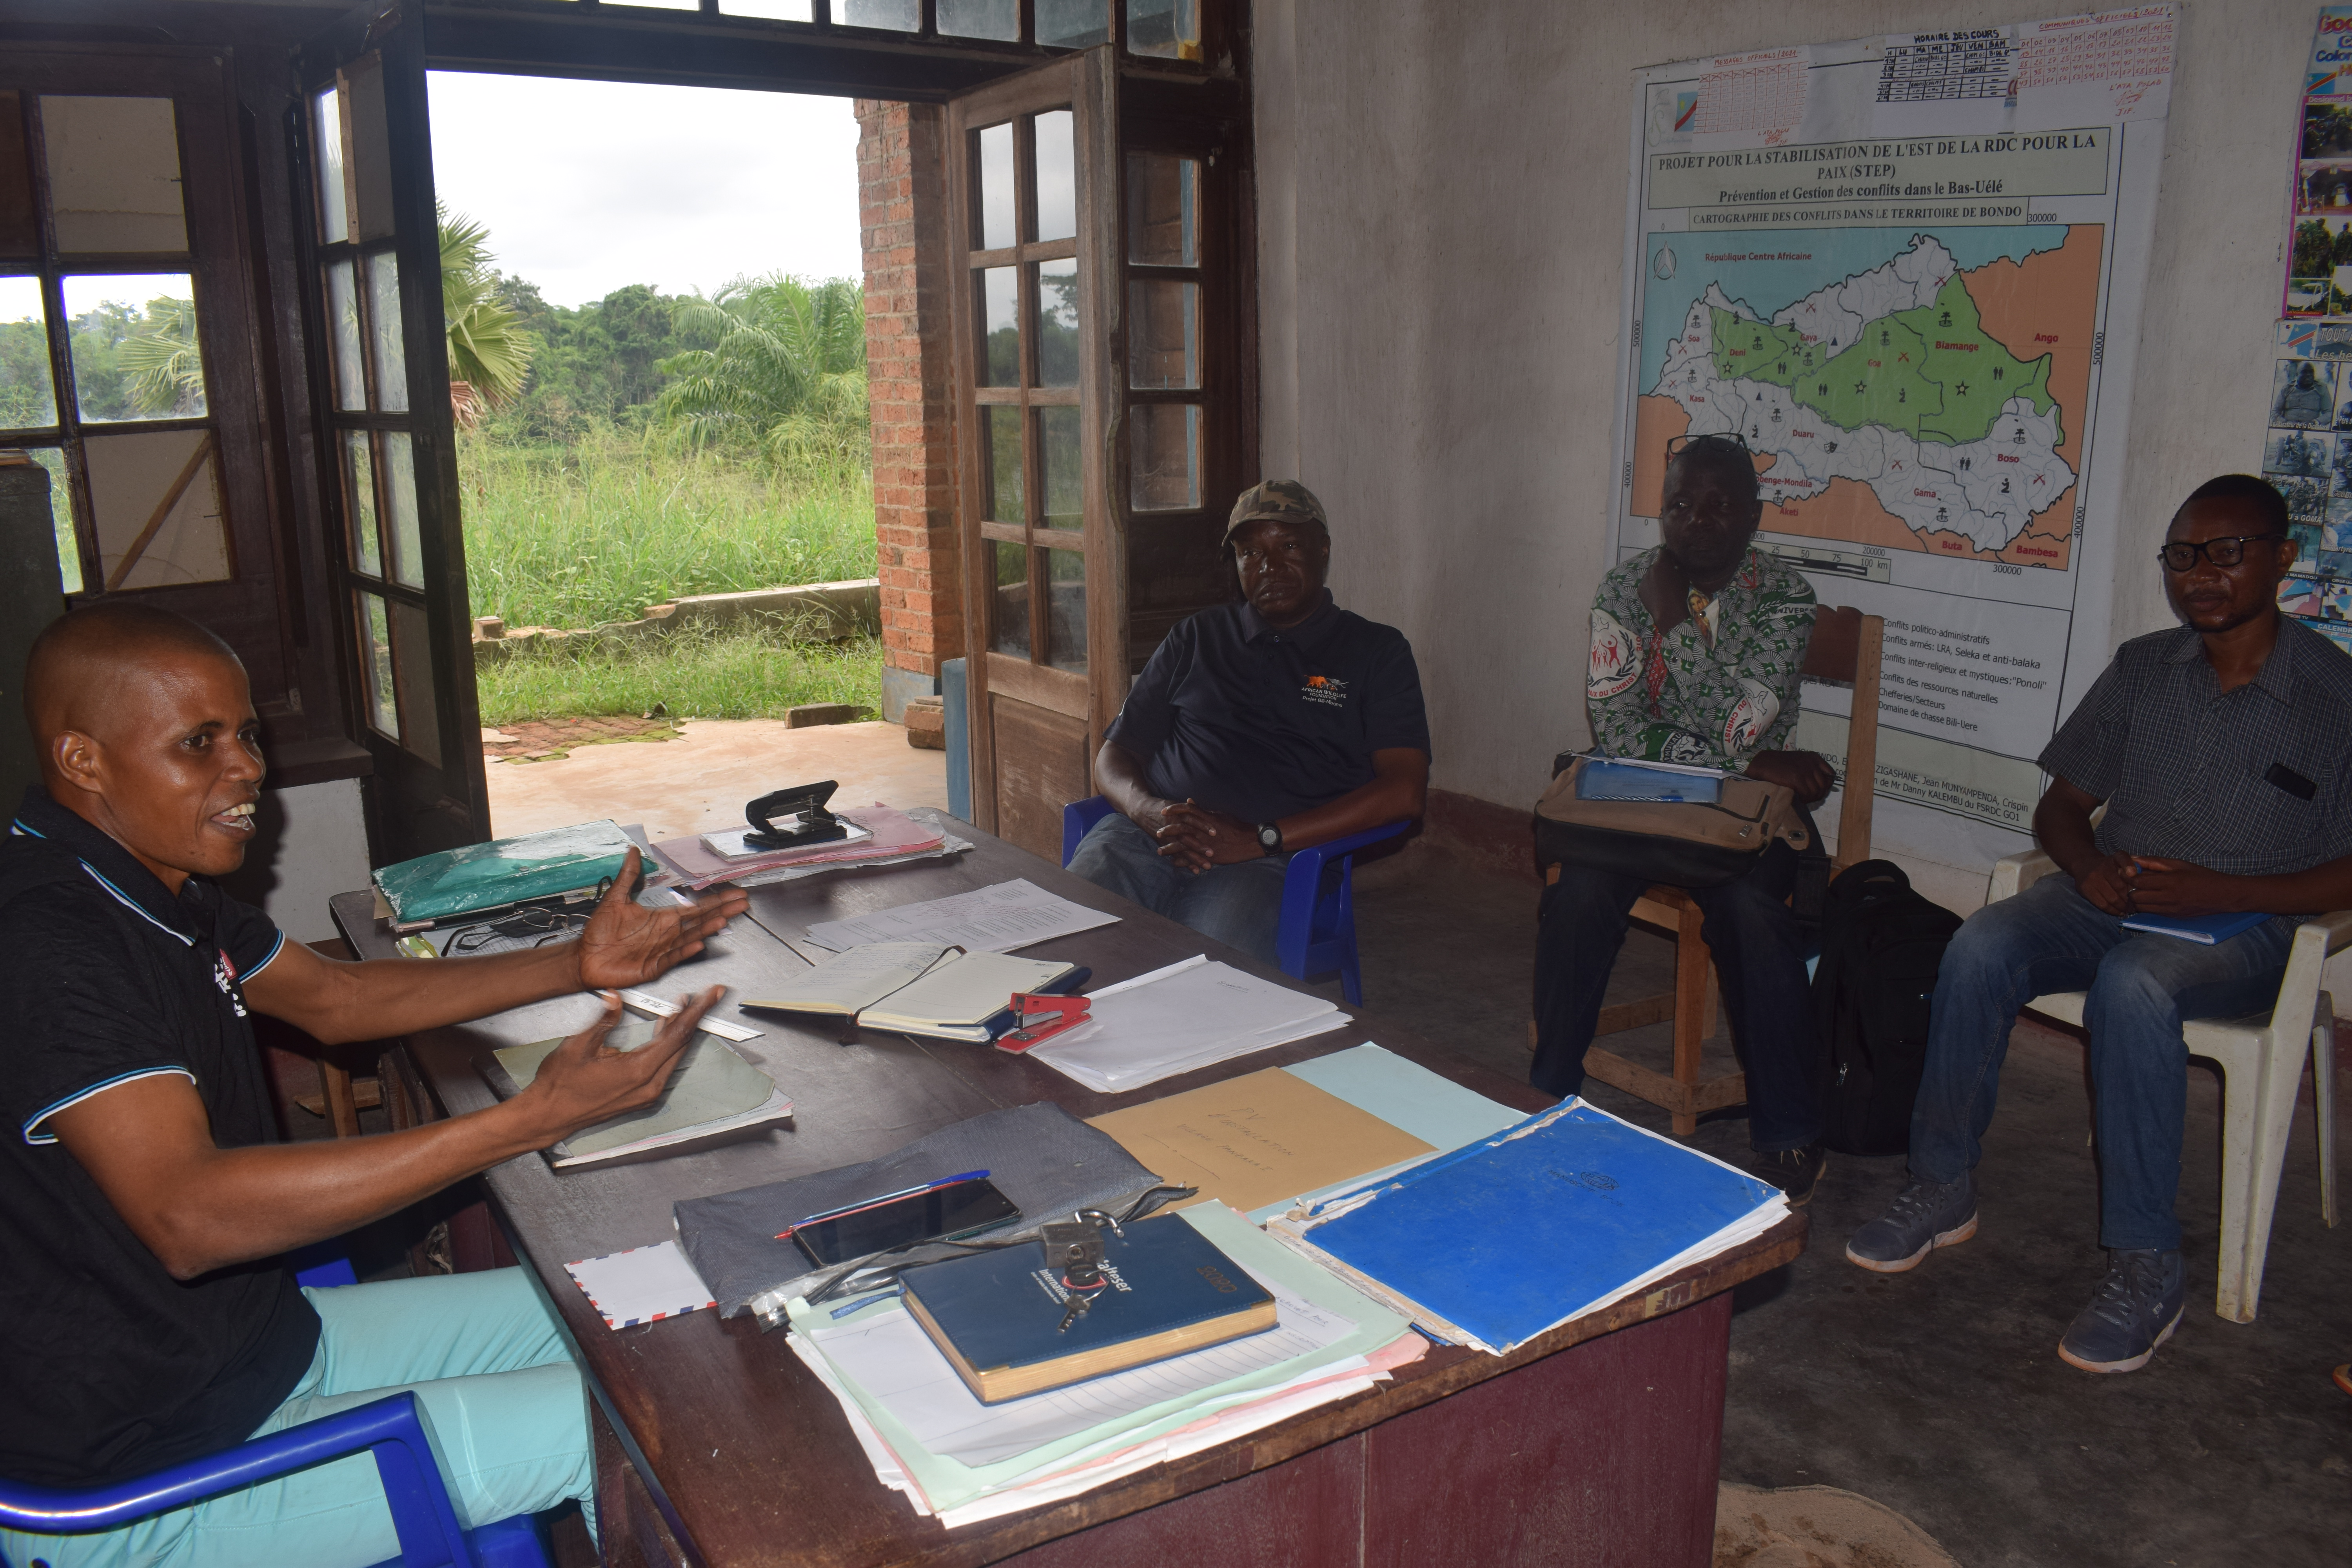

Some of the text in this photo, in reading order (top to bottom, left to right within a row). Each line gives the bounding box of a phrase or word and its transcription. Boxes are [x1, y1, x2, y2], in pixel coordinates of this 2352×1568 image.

[2039, 18, 2089, 29] COMMUNIQUES
[1914, 29, 1999, 44] HORAIRE DES COURS
[1989, 40, 2006, 48] SAM
[1659, 134, 2096, 170] PROJET POUR LA STABILISATION DE L'EST DE LA RDC POUR LA
[1817, 163, 1896, 180] PAIX (STEP)
[1719, 179, 2002, 202] Prévention et Gestion des conflits dans le Bas-Uélé
[1693, 206, 2022, 224] CARTOGRAPHIE DES CONFLITS DANS LE TERRITOIRE DE BONDO
[2028, 214, 2056, 223] 300000
[1705, 253, 1746, 262] République
[1800, 334, 1817, 343] Gaya
[2034, 334, 2058, 343] Ango
[2320, 328, 2348, 342] TOUT
[1935, 341, 1978, 351] Biamange
[2093, 332, 2103, 365] 500000
[2314, 349, 2335, 360] Les
[1868, 359, 1881, 367] Goa
[1792, 430, 1814, 438] Duaru
[1997, 454, 2019, 463] Boso
[1757, 476, 1812, 488] obenge-Mondila
[1914, 488, 1936, 498] Gama
[1780, 508, 1798, 516] Aketi
[2074, 506, 2083, 539] 400000
[1772, 546, 1780, 554] 25
[1863, 546, 1885, 557] 200000
[1942, 541, 1962, 550] Buta
[2016, 546, 2058, 557] Bambesa
[1832, 554, 1841, 562] 75
[1862, 559, 1888, 570] 100 km
[1993, 564, 2022, 575] 300000
[1884, 618, 1990, 645] Conflits politico-administratifs
[1882, 633, 2040, 669] Conflits armés: LRA, Seleka et anti-balaka
[1881, 652, 1906, 664] Conflits
[1908, 657, 1956, 675] inter-religieux
[1959, 668, 1967, 677] et
[1611, 672, 1636, 693] CHRIST
[1819, 678, 1835, 687] RCA
[1880, 671, 1998, 704] Conflits des ressources naturelles
[1879, 687, 1945, 710] Chefferies/Secteurs
[1725, 700, 1746, 743] DU CHRIST
[1878, 701, 1978, 731] Domaine de chasse Bili-Uere
[1876, 765, 2028, 812] ZIGASHANE, Jean MUNYAMPENDA, Crispin
[1880, 778, 1889, 787] de
[1891, 780, 1901, 789] Mr
[1903, 784, 1925, 797] Danny
[1928, 789, 1962, 805] KALEMBU
[1965, 800, 1973, 808] du
[1977, 803, 2001, 817] FSRDC
[1096, 1256, 1132, 1291] alteser
[1197, 1265, 1237, 1293] 2020
[1039, 1269, 1070, 1303] Internation
